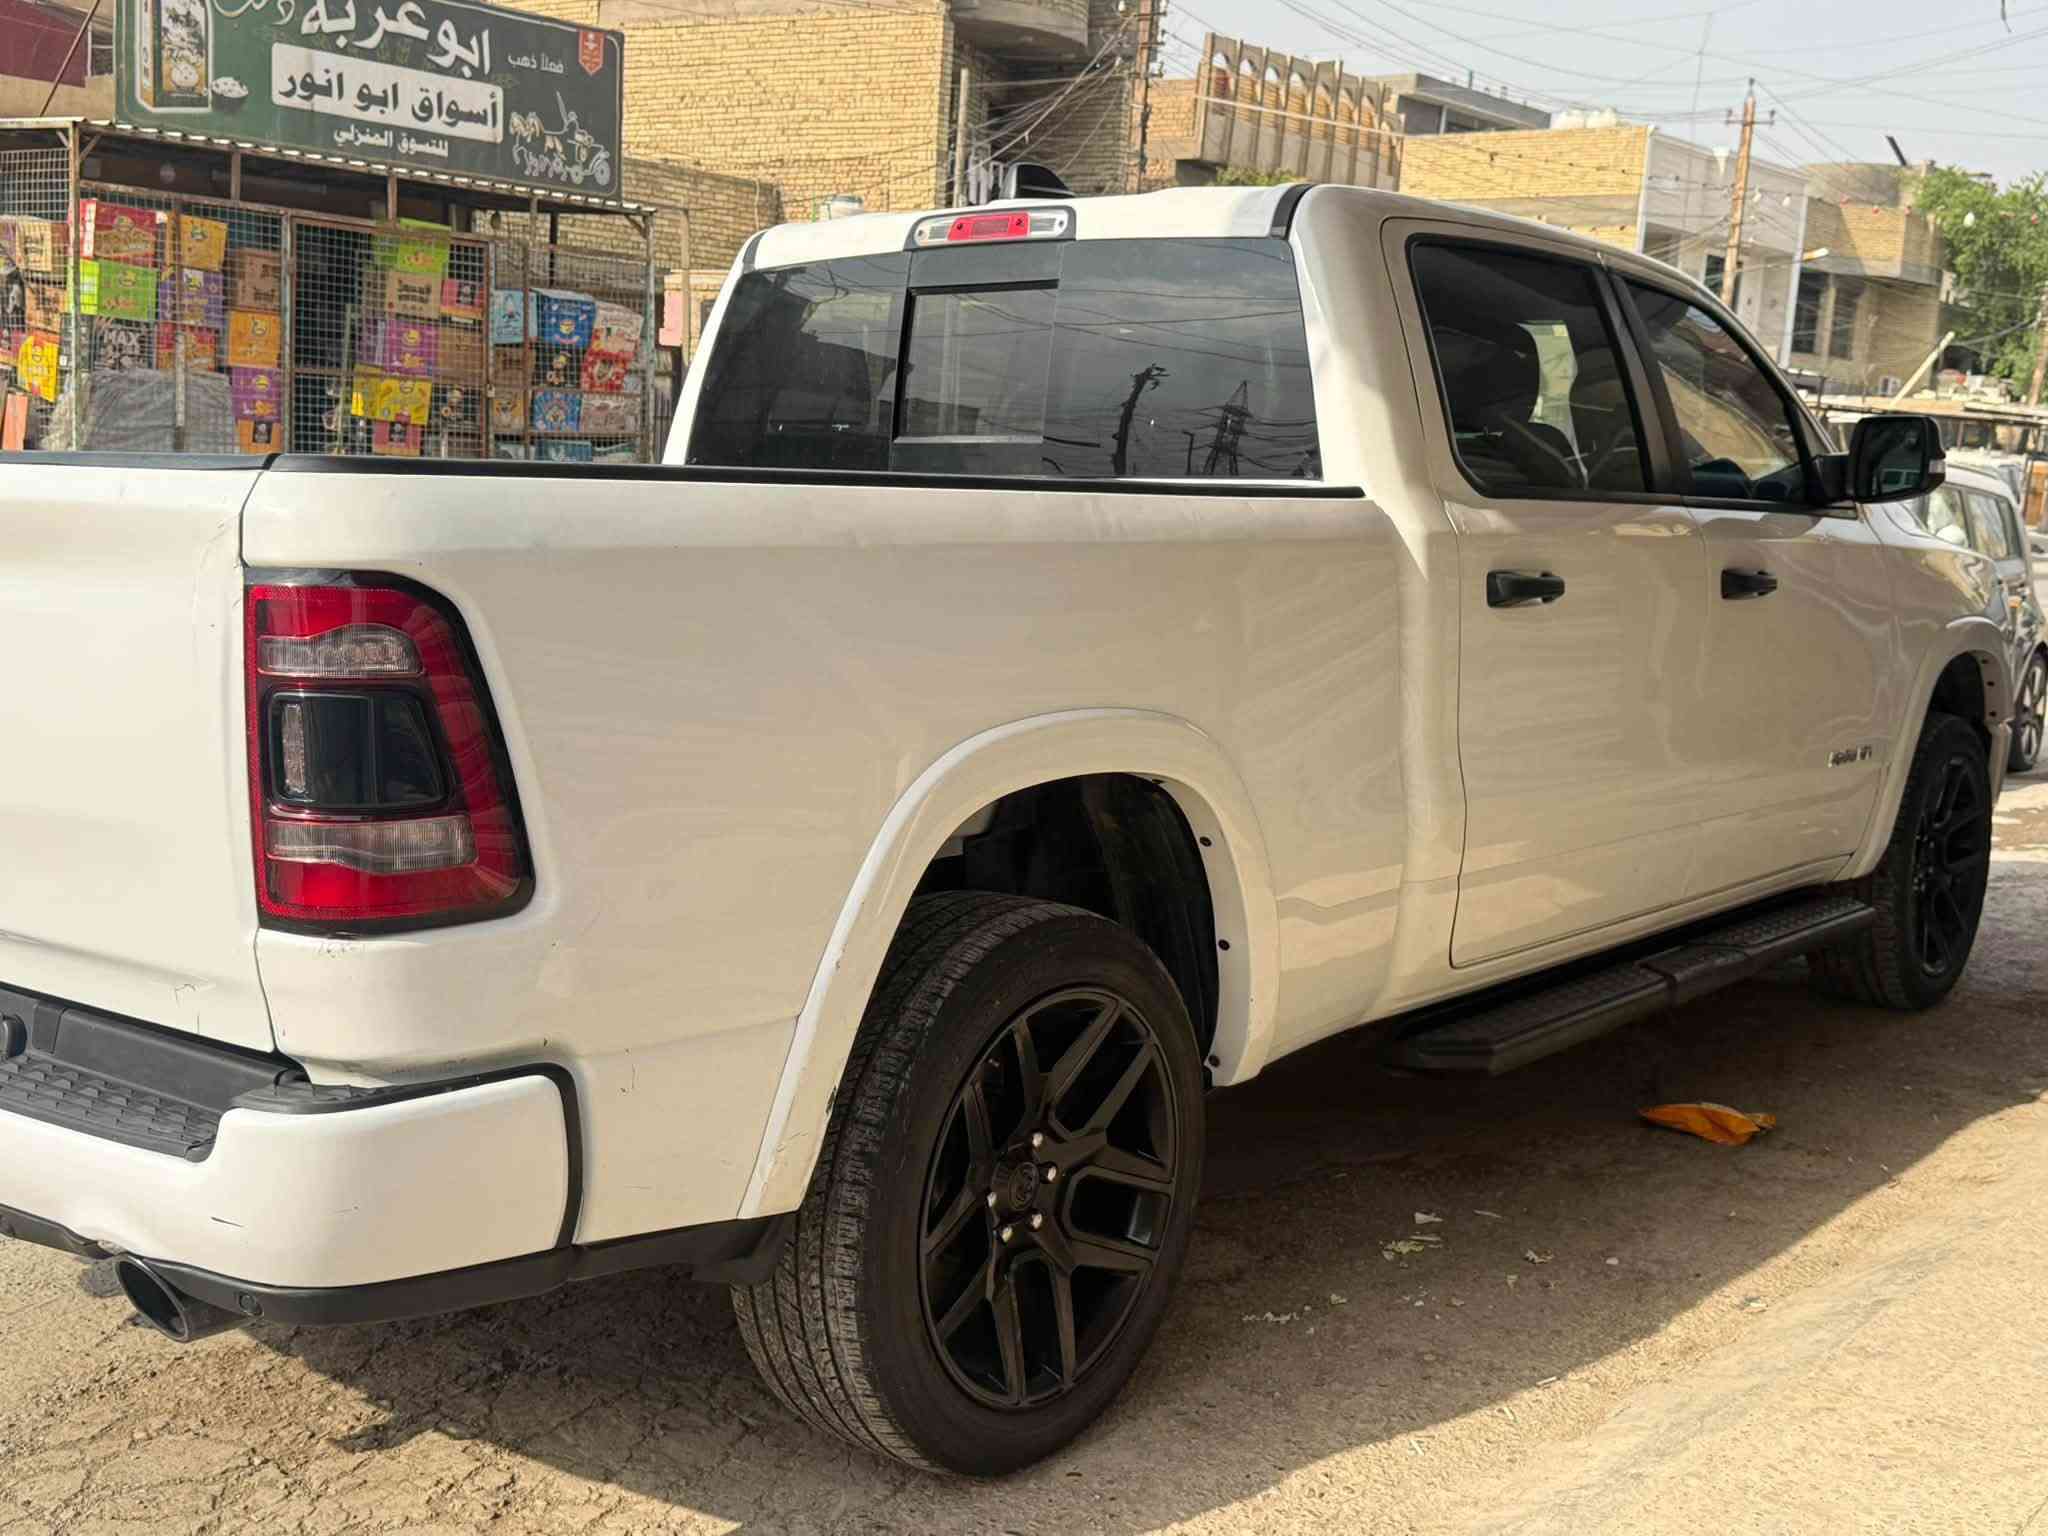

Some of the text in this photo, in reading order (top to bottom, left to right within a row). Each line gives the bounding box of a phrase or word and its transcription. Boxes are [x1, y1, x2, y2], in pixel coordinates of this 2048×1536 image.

[425, 19, 491, 78] ابو
[279, 69, 498, 128] أسواق ابو انور
[333, 123, 449, 157] للتسوق المنزلي
